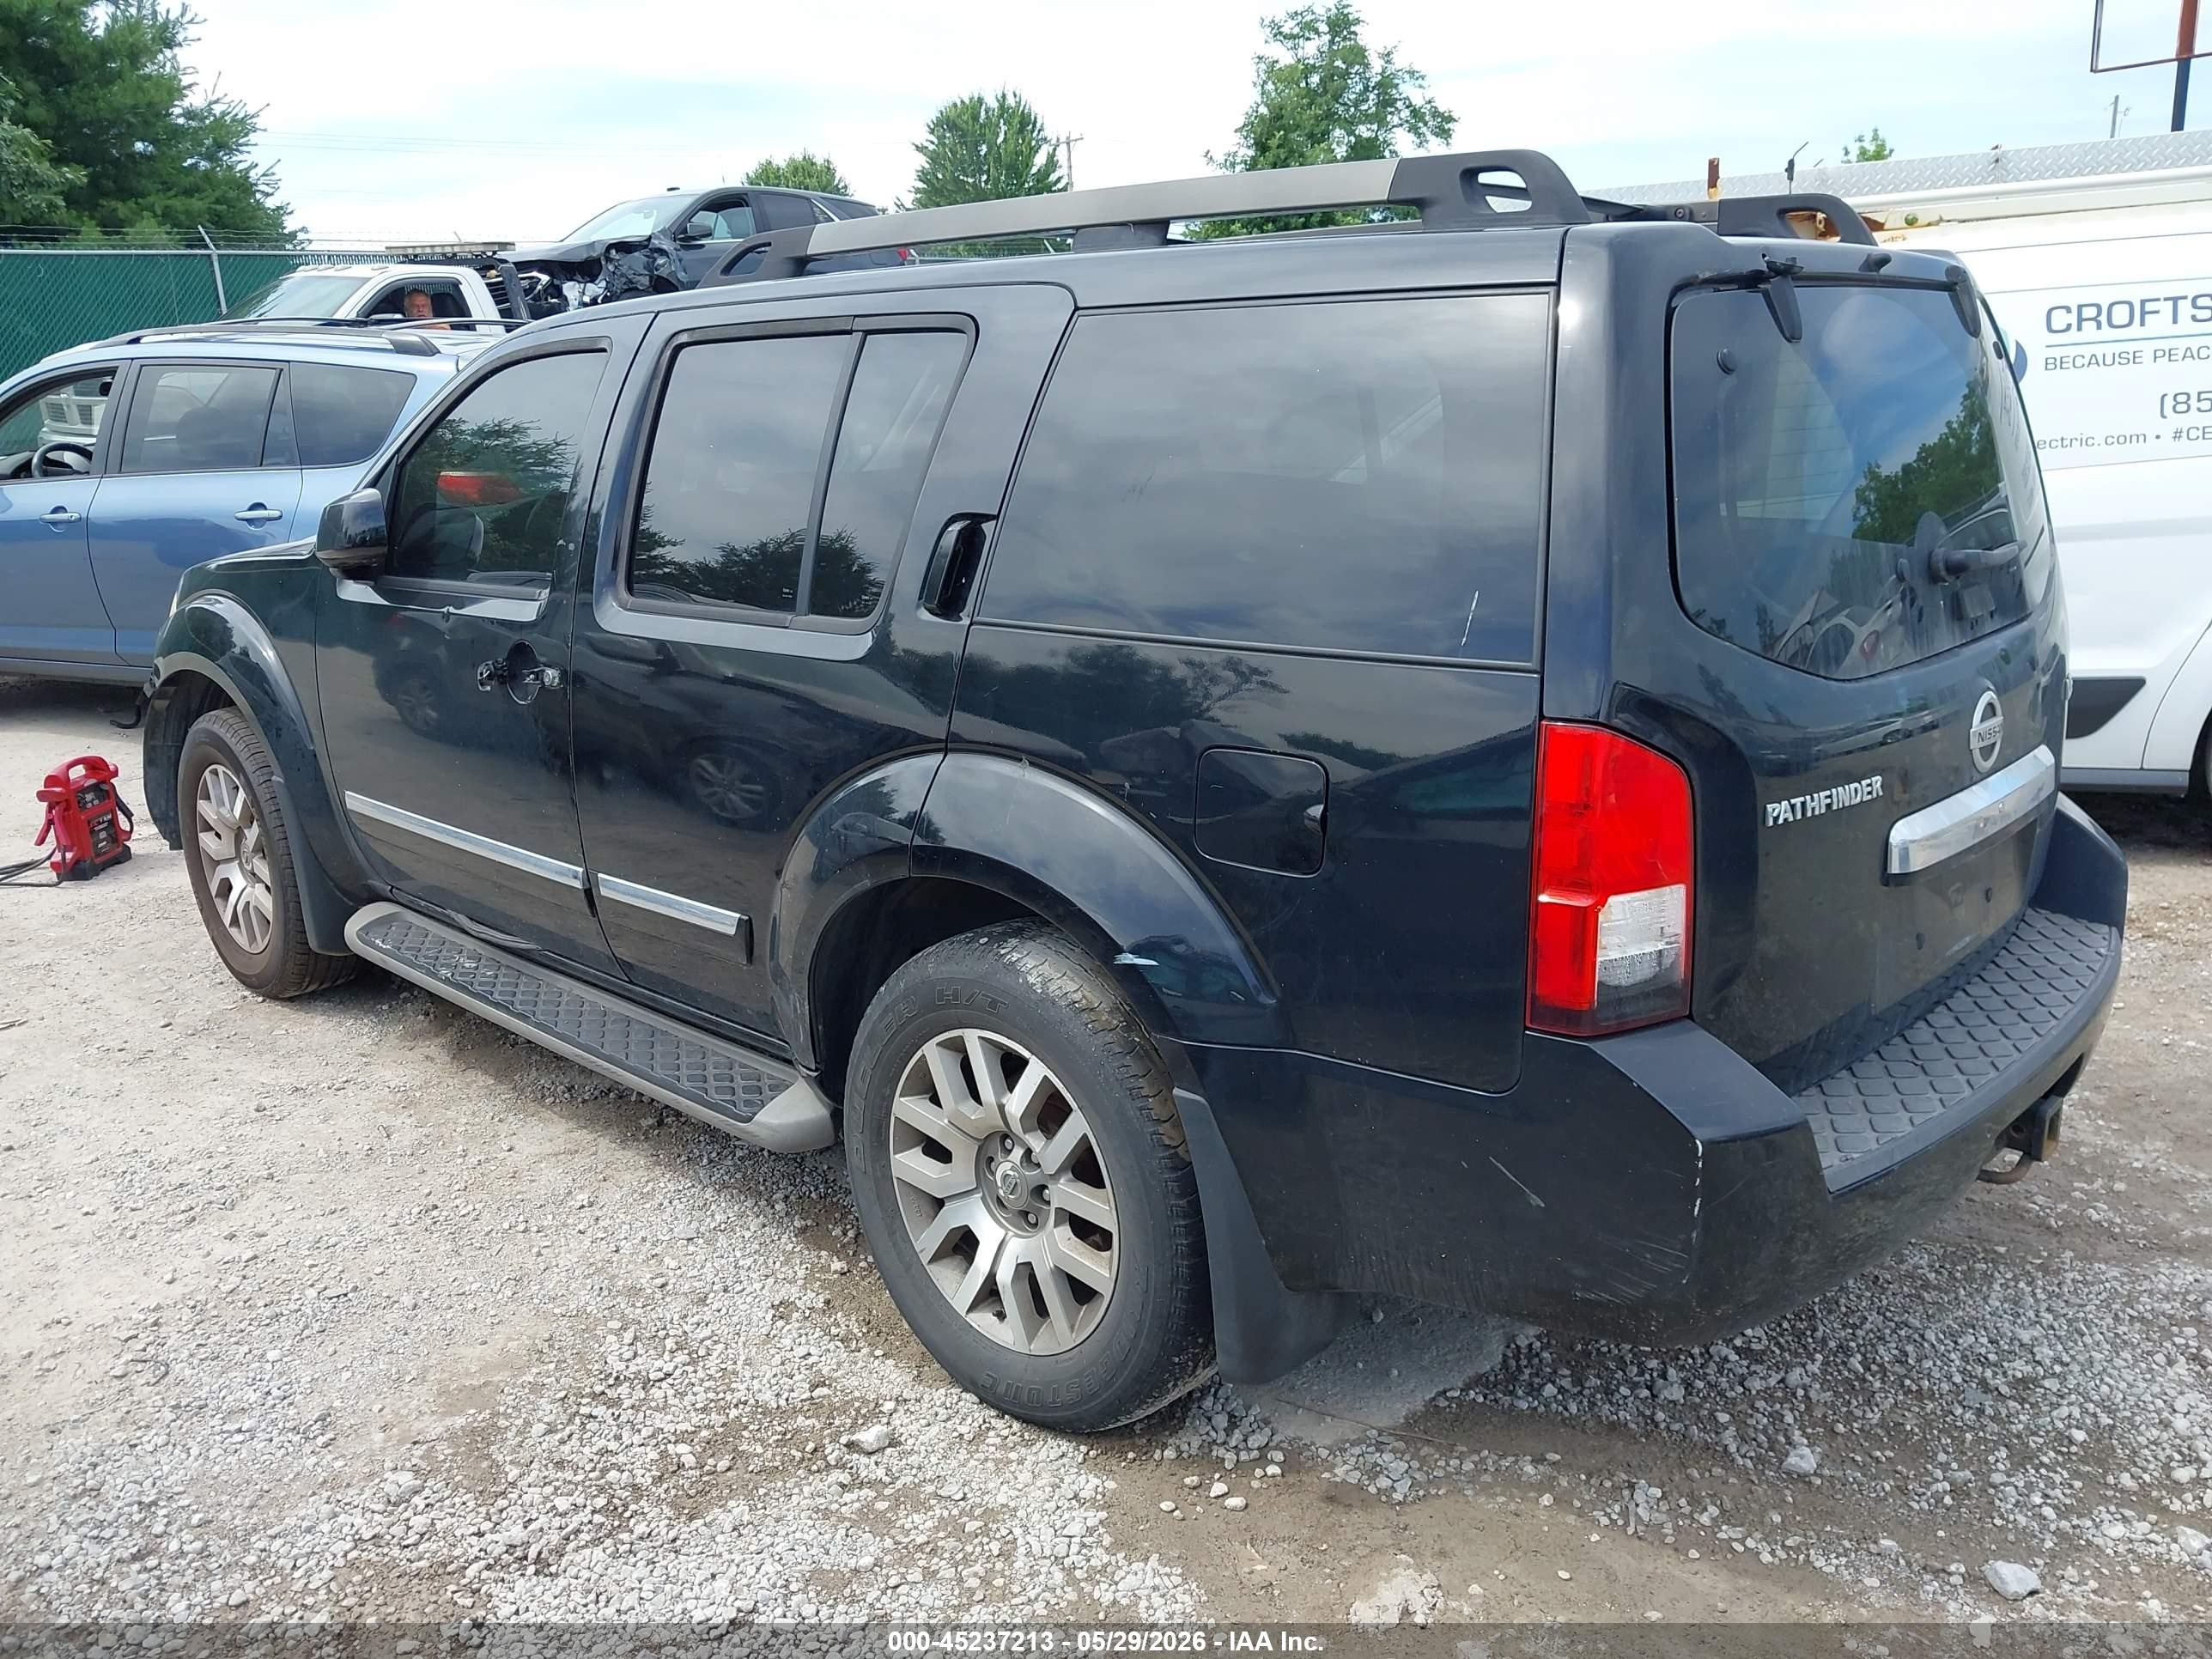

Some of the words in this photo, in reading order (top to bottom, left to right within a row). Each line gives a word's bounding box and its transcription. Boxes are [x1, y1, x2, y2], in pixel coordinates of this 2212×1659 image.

[2045, 293, 2212, 334] CROFTS
[2045, 349, 2144, 372] BECAUSE
[2160, 390, 2212, 420] (85
[2036, 432, 2147, 451] ectric.com
[1977, 721, 2003, 744] NISS
[1765, 775, 1884, 828] PATHFINDER
[934, 987, 1010, 1014] H/T
